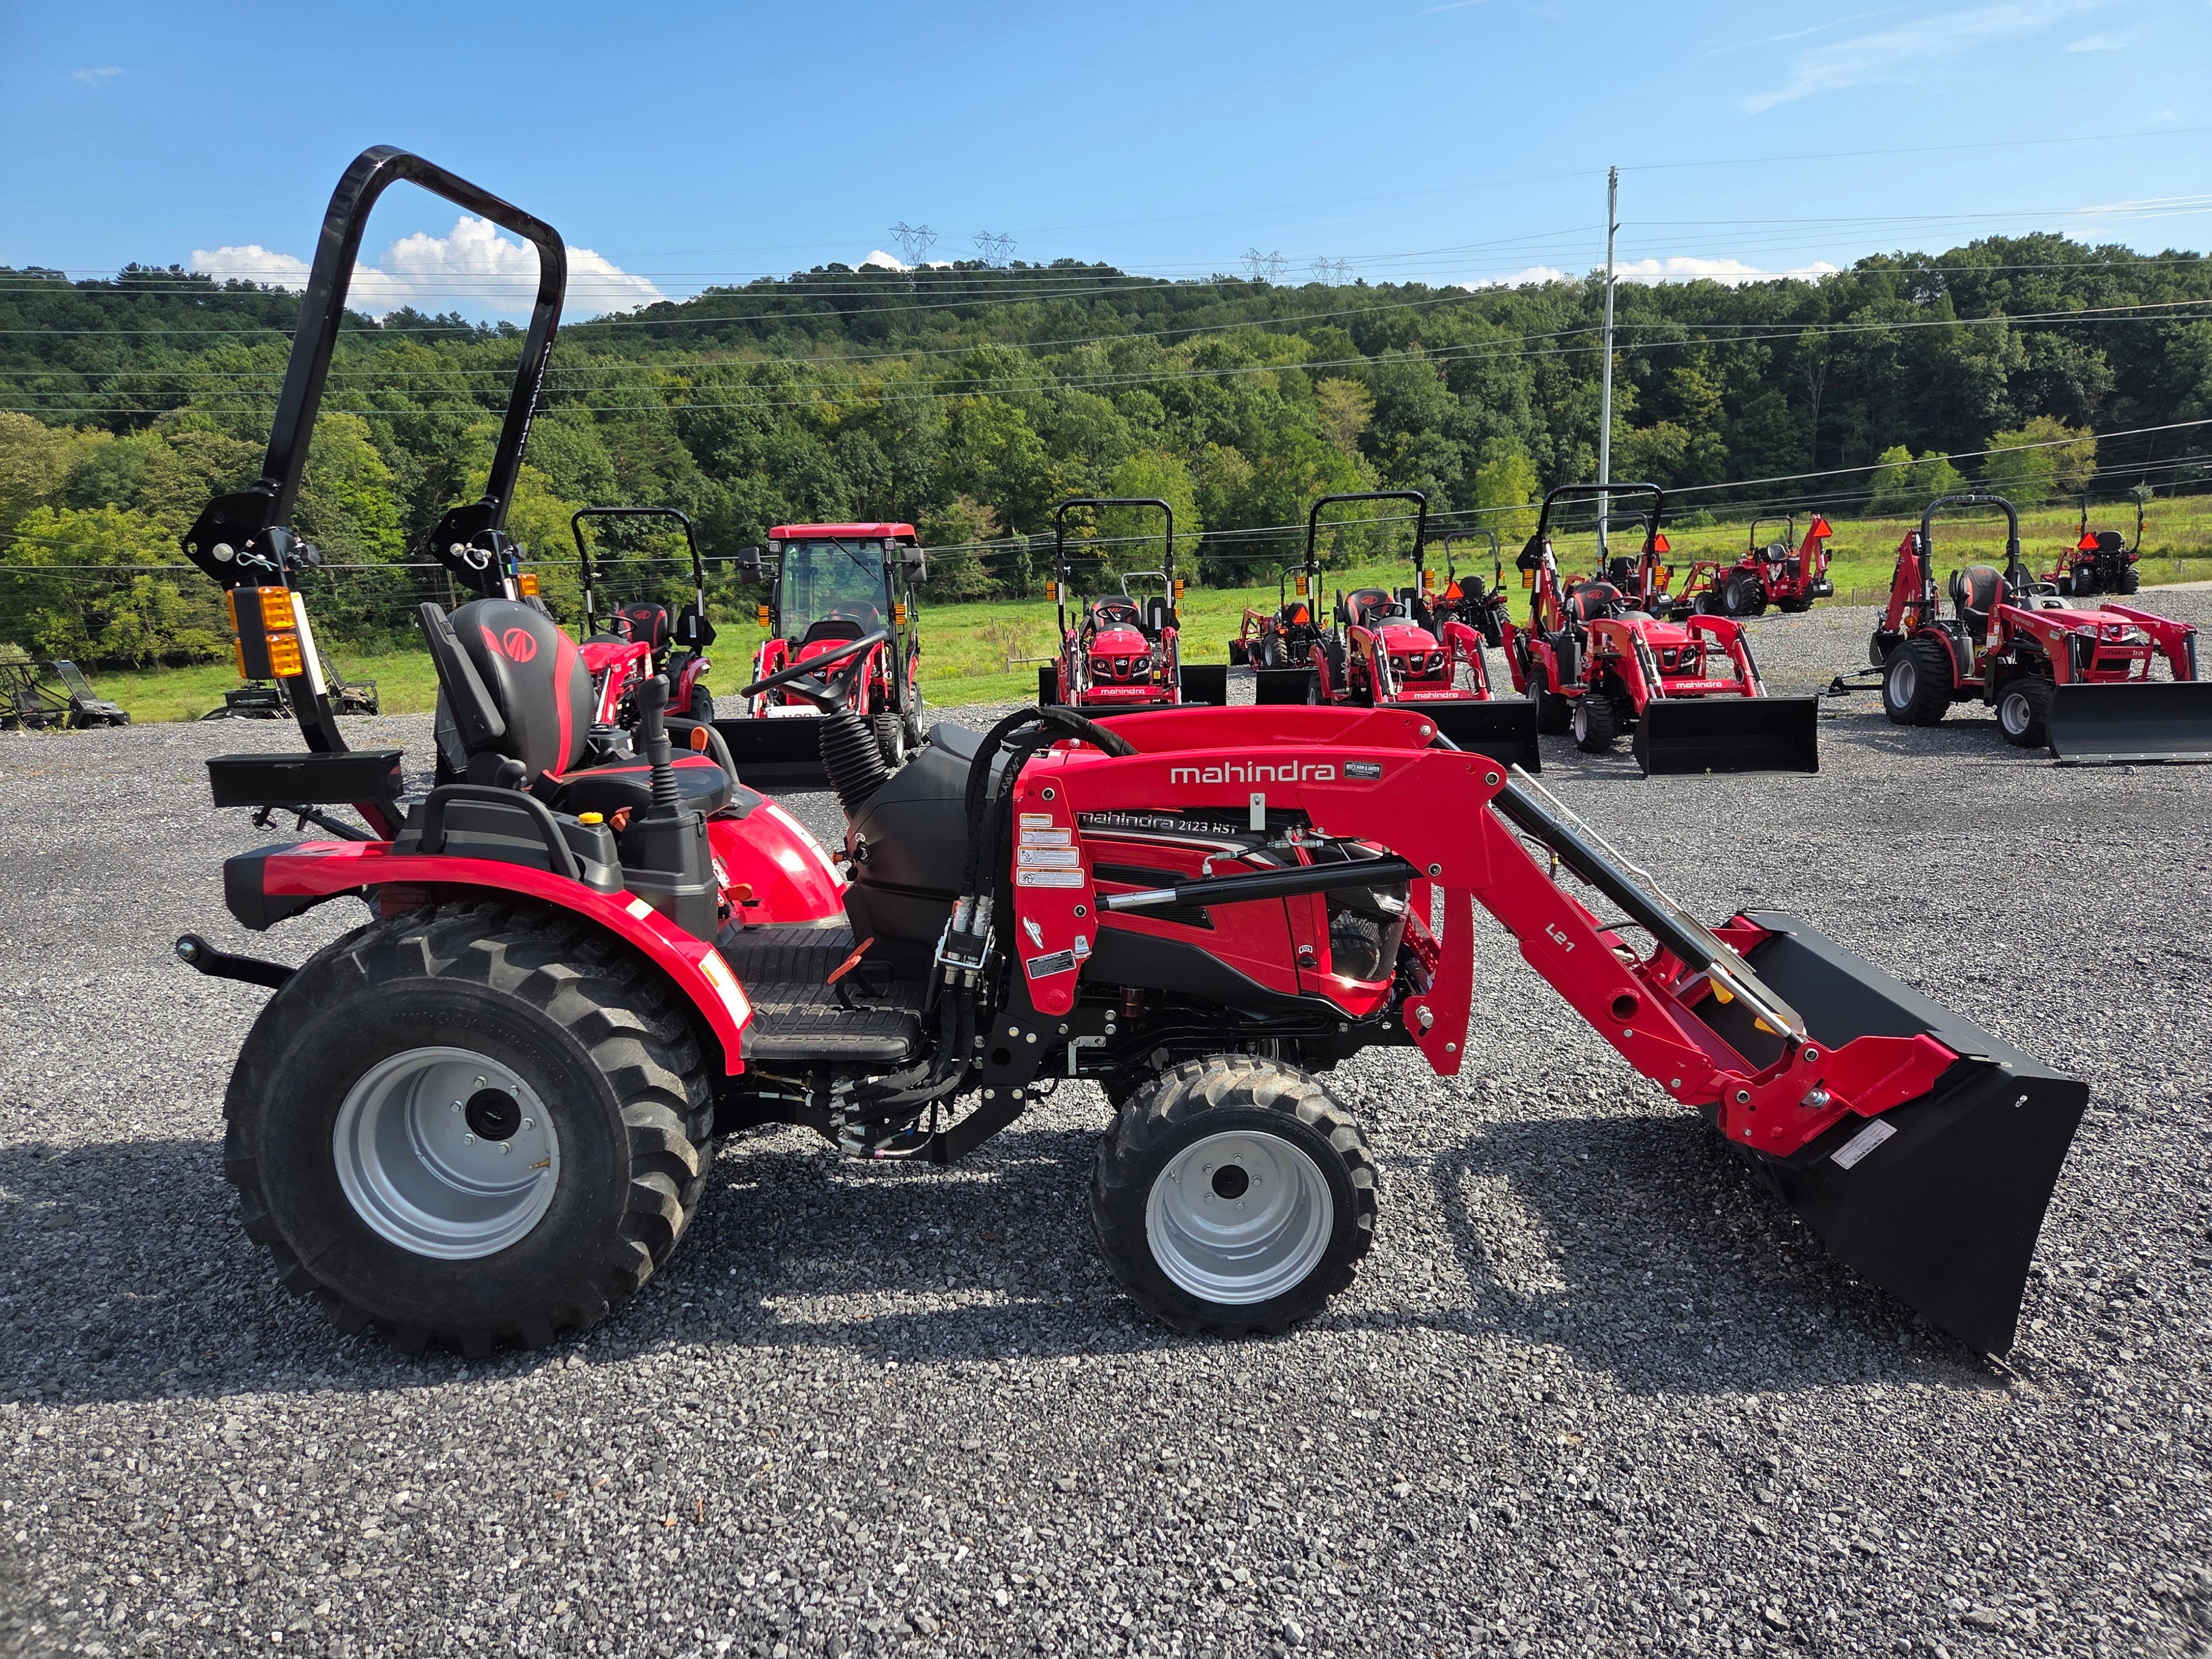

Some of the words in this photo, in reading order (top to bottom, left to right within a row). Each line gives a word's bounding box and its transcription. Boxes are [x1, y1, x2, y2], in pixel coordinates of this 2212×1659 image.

[1171, 760, 1335, 783] mahindra
[1075, 811, 1174, 830] mahindra
[1178, 820, 1209, 832] 2123
[1212, 823, 1238, 835] HST
[1545, 923, 1575, 952] L21
